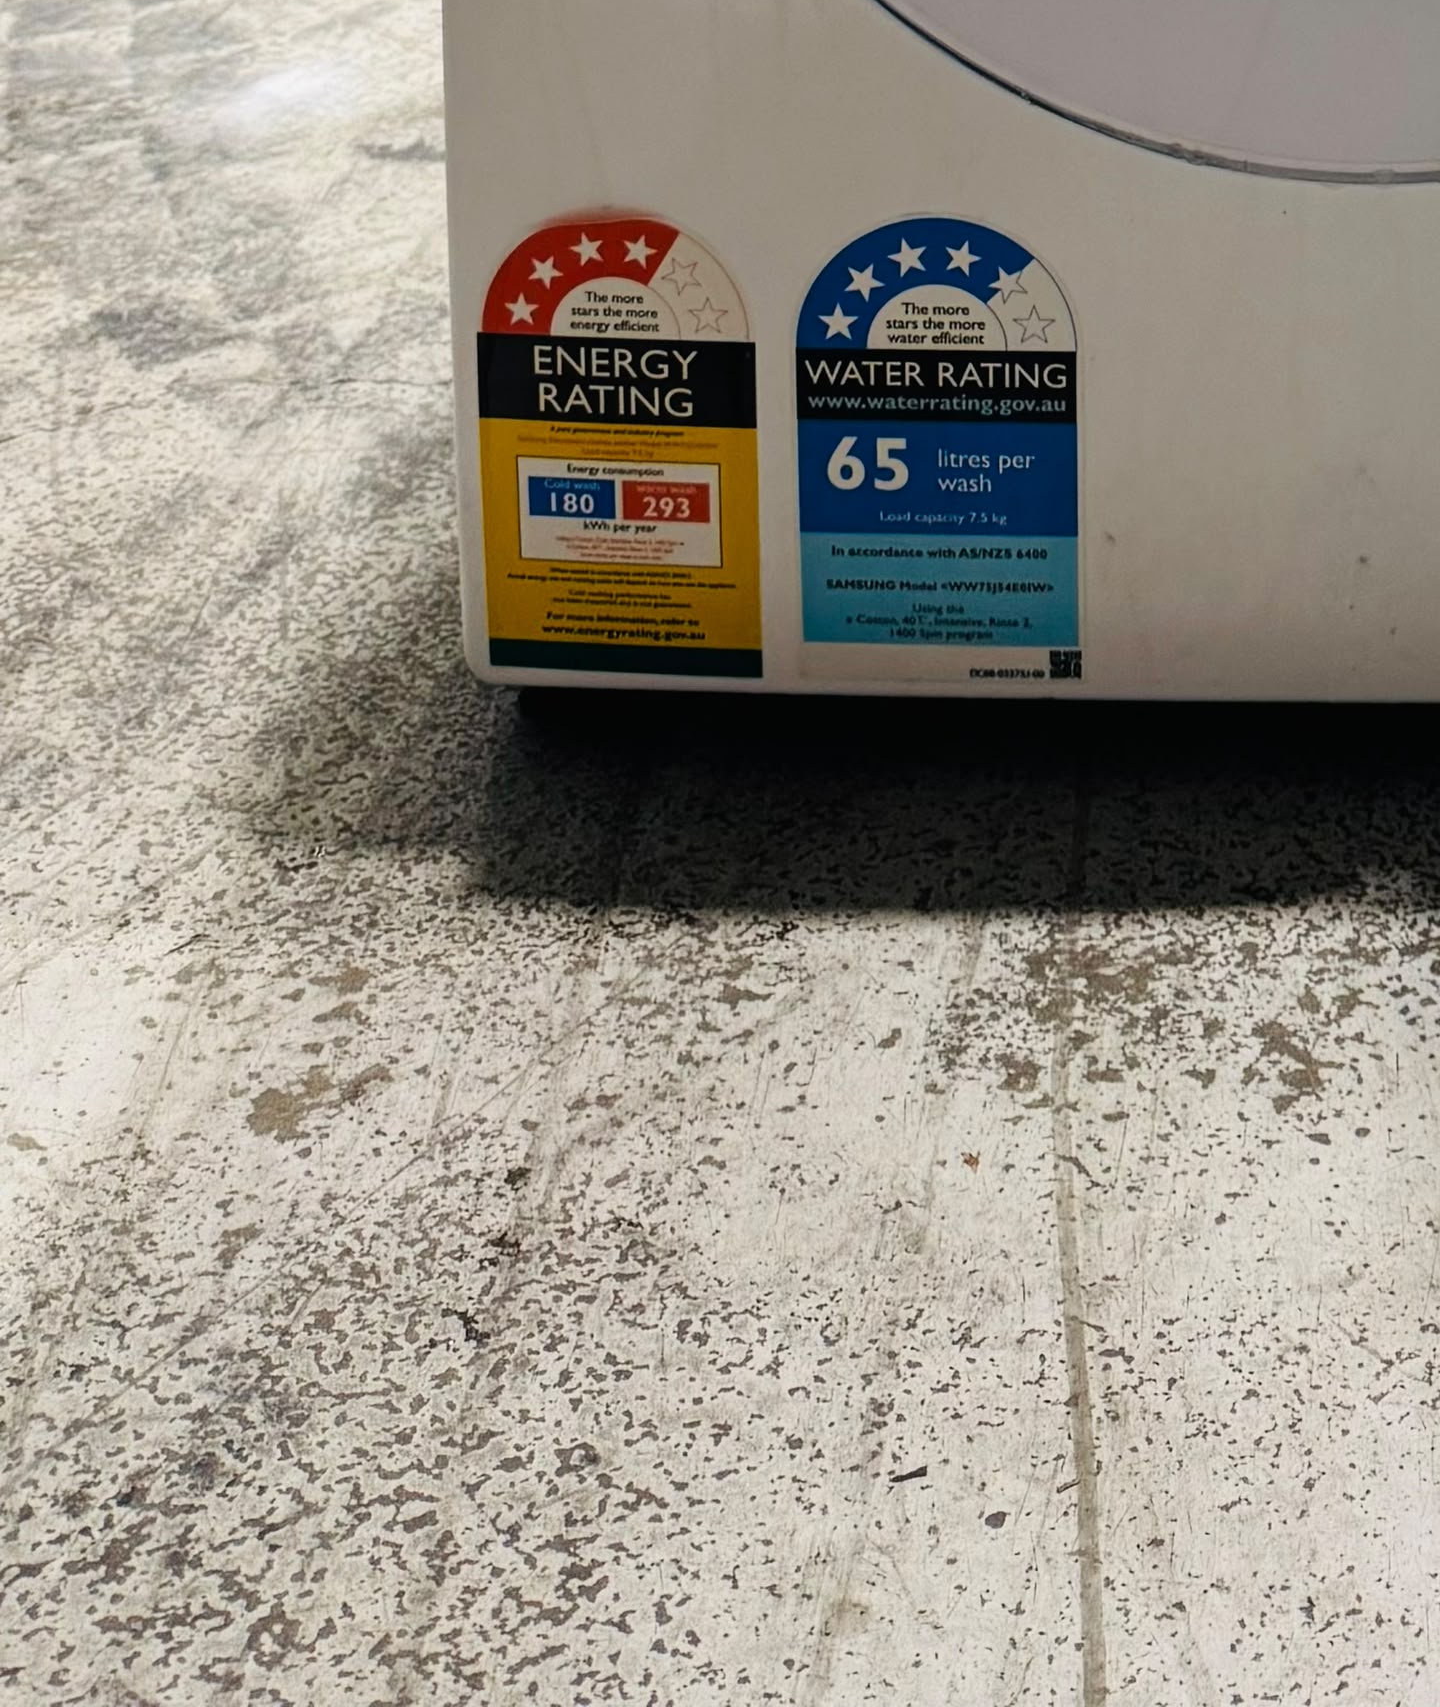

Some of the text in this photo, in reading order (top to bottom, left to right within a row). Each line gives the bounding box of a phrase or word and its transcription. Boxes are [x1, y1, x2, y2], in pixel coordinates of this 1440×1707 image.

[585, 291, 644, 304] The more
[571, 307, 658, 319] stars the more
[901, 302, 970, 316] The more
[570, 321, 660, 333] energy efficient
[886, 317, 986, 331] stars the more
[887, 332, 985, 345] water efficient
[533, 345, 698, 380] ENERGY
[804, 359, 1068, 389] WATER RATING
[538, 382, 694, 417] RATING
[807, 394, 1066, 416] www.waterrating.gov.au
[827, 435, 909, 491] 65
[937, 448, 1036, 475] litres per
[567, 463, 664, 478] Energy consumption
[544, 479, 600, 491] Cold wash
[938, 473, 992, 493] wash
[550, 492, 595, 515] 180
[643, 497, 691, 519] 293
[880, 510, 1007, 525] Load capacity 7.5 kg
[583, 521, 657, 535] kWh per year
[831, 545, 844, 556] In
[847, 546, 924, 558] accordance
[927, 548, 956, 559] with
[958, 548, 1012, 560] AS/NZS
[826, 579, 896, 591] SAMSUNG
[899, 580, 938, 592] Model
[546, 611, 564, 621] For
[542, 624, 706, 641] www.energyrating.gov.au
